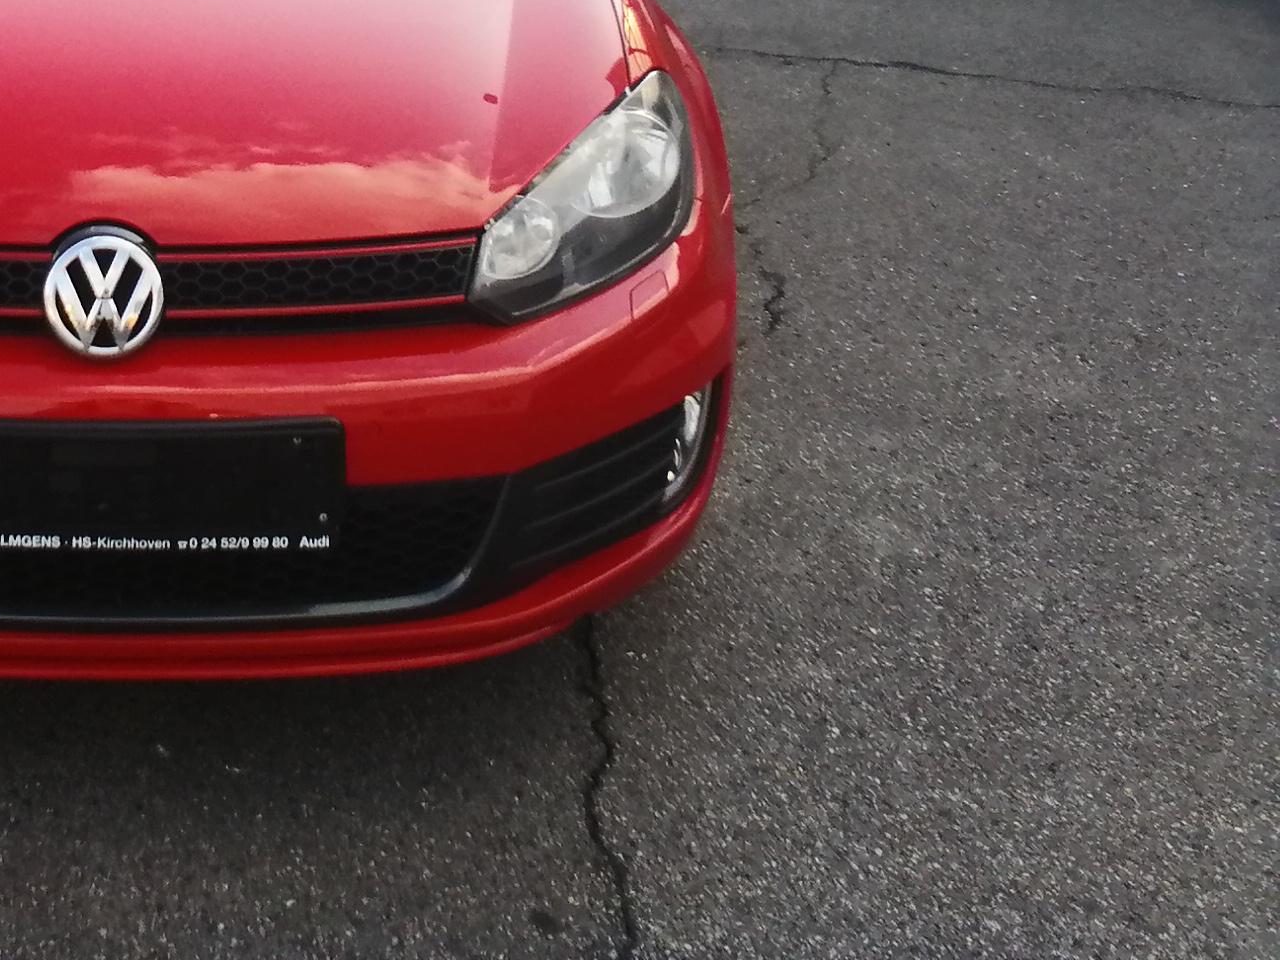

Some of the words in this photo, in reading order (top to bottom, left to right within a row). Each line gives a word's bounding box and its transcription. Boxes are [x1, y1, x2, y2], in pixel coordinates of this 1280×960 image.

[43, 235, 164, 357] VW
[71, 536, 171, 550] HS-Kirchhoven
[201, 537, 218, 549] 24
[299, 535, 330, 548] Audi
